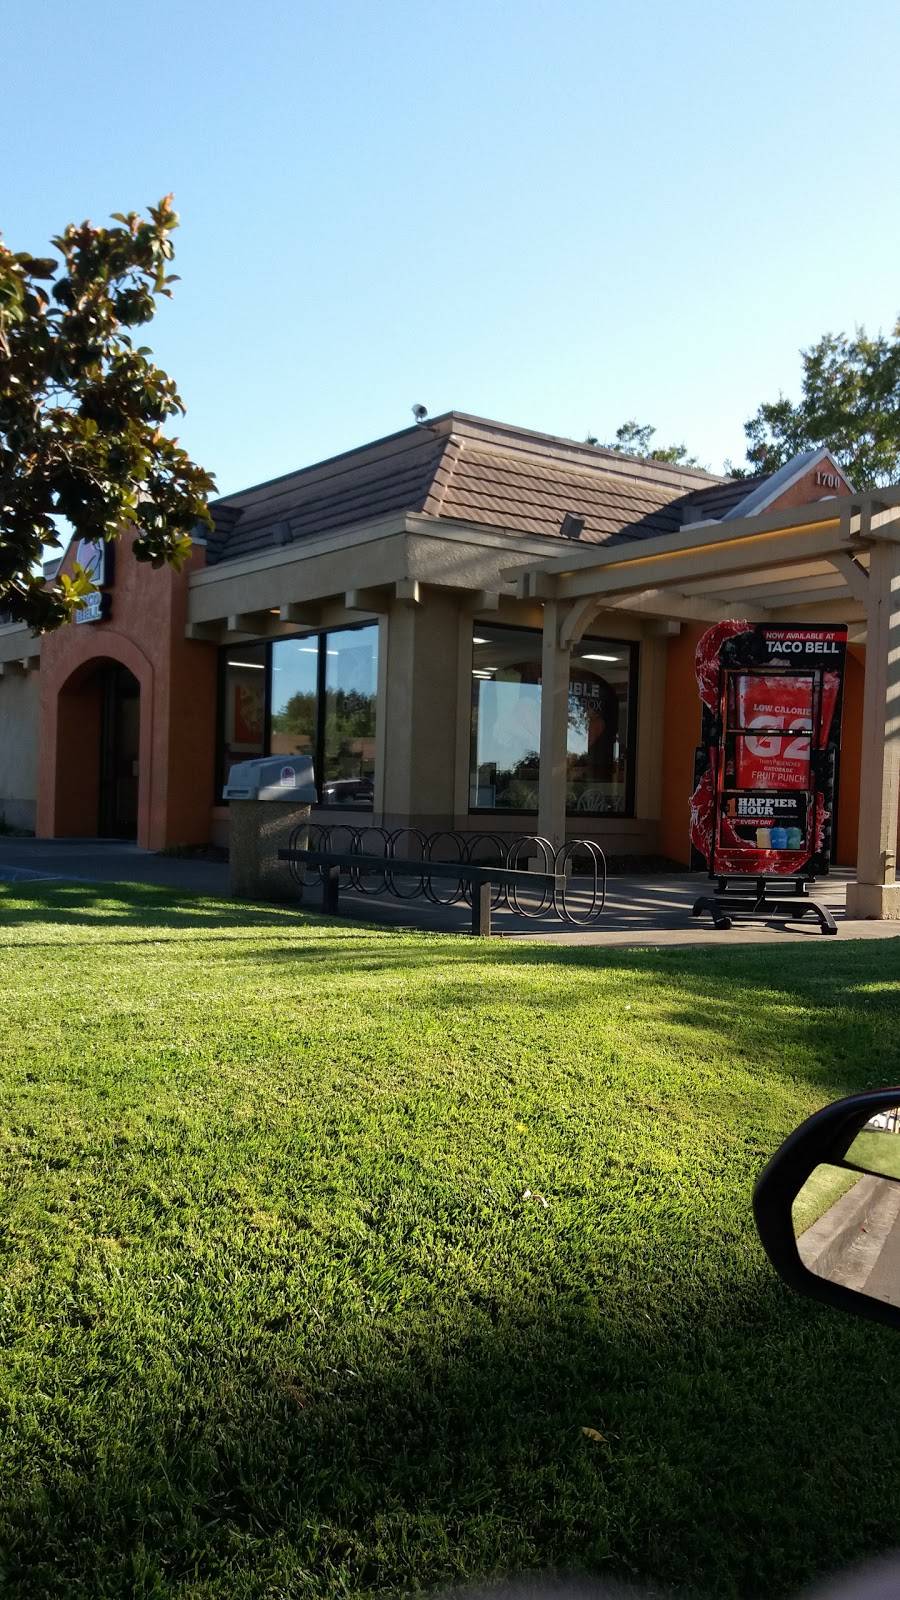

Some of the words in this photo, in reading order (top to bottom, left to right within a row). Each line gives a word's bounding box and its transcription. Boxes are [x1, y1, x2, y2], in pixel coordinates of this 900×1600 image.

[816, 471, 841, 489] 1700
[786, 632, 824, 640] AVAILABLE
[766, 641, 803, 653] TACO
[805, 641, 840, 654] BELL
[752, 704, 773, 712] LOW
[744, 715, 812, 761] G2
[752, 770, 776, 780] FRUIT
[777, 773, 806, 783] PUNCH
[738, 797, 797, 807] HAPPIER
[738, 806, 774, 815] HOUR
